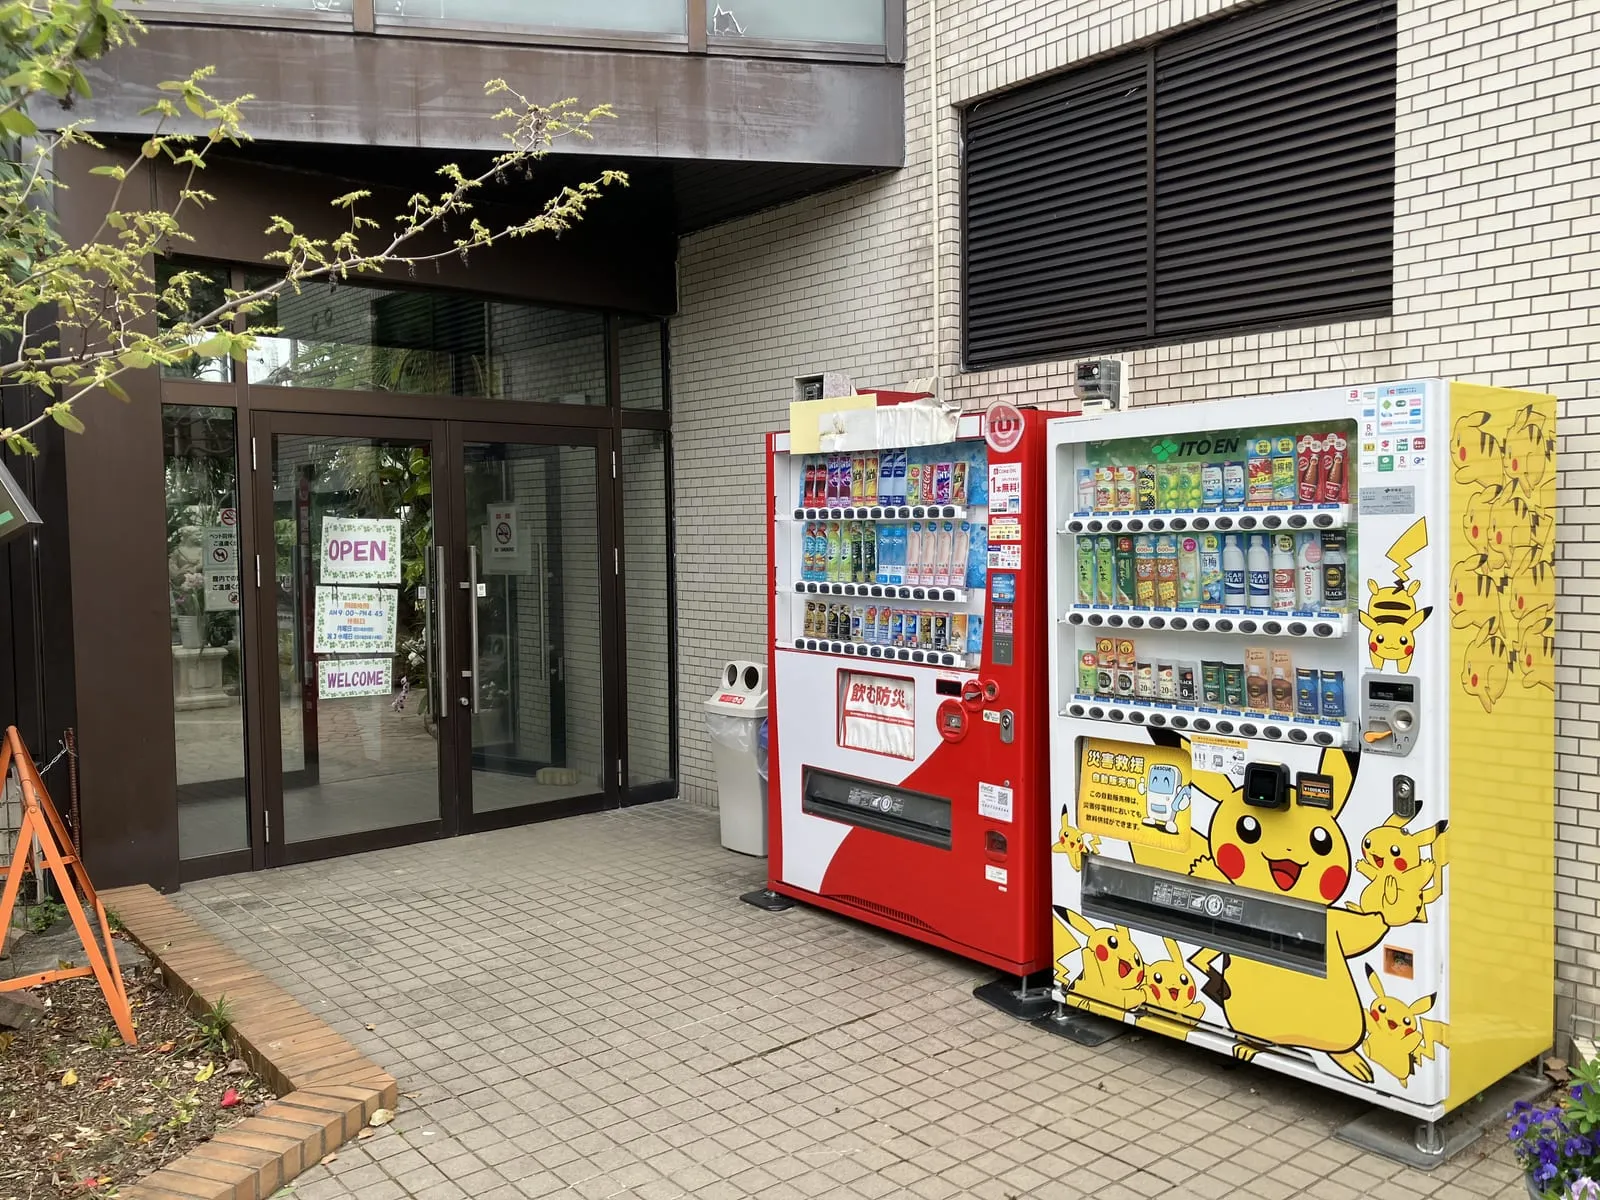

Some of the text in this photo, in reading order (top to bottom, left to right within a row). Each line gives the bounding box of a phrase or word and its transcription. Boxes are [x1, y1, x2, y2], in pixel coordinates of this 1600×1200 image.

[1178, 438, 1240, 457] ITO EN
[328, 540, 386, 562] OPEN
[1304, 570, 1313, 596] evian
[328, 670, 384, 688] WELCOME
[850, 683, 906, 710] 飲む防災
[1087, 750, 1144, 774] 災害救援
[1092, 772, 1136, 789] 自動販売機
[1089, 790, 1139, 806] この自動販売機は、
[1083, 802, 1142, 818] 災害停電時においても
[1086, 814, 1140, 830] 飲料供給ができます。
